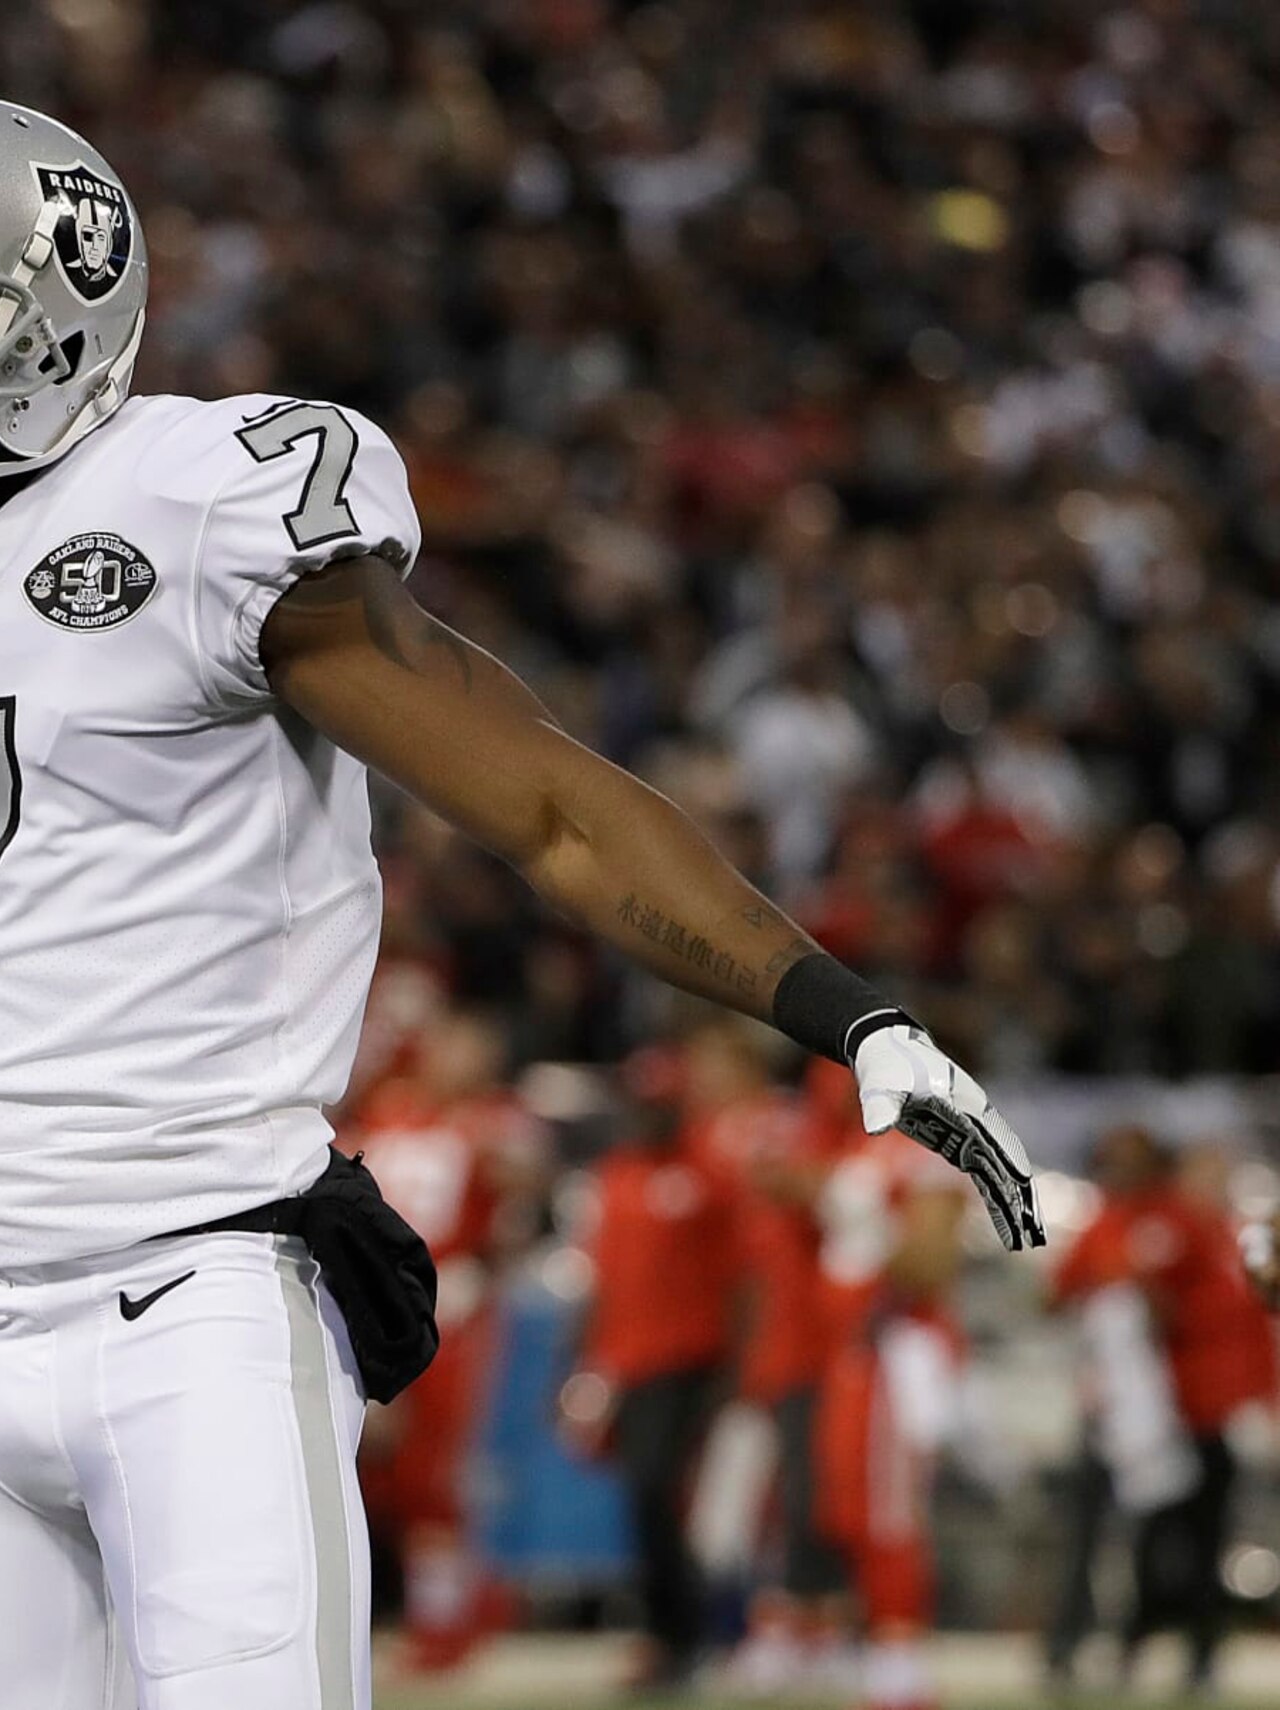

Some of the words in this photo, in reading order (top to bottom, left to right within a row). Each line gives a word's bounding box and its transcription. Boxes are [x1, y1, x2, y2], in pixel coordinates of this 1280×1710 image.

[48, 172, 121, 203] RAIDERS
[233, 402, 362, 552] 7
[48, 538, 95, 565] OAKLAND
[96, 538, 136, 562] RAIDERS
[60, 560, 121, 602] 50
[69, 604, 129, 626] CHAMPIONS
